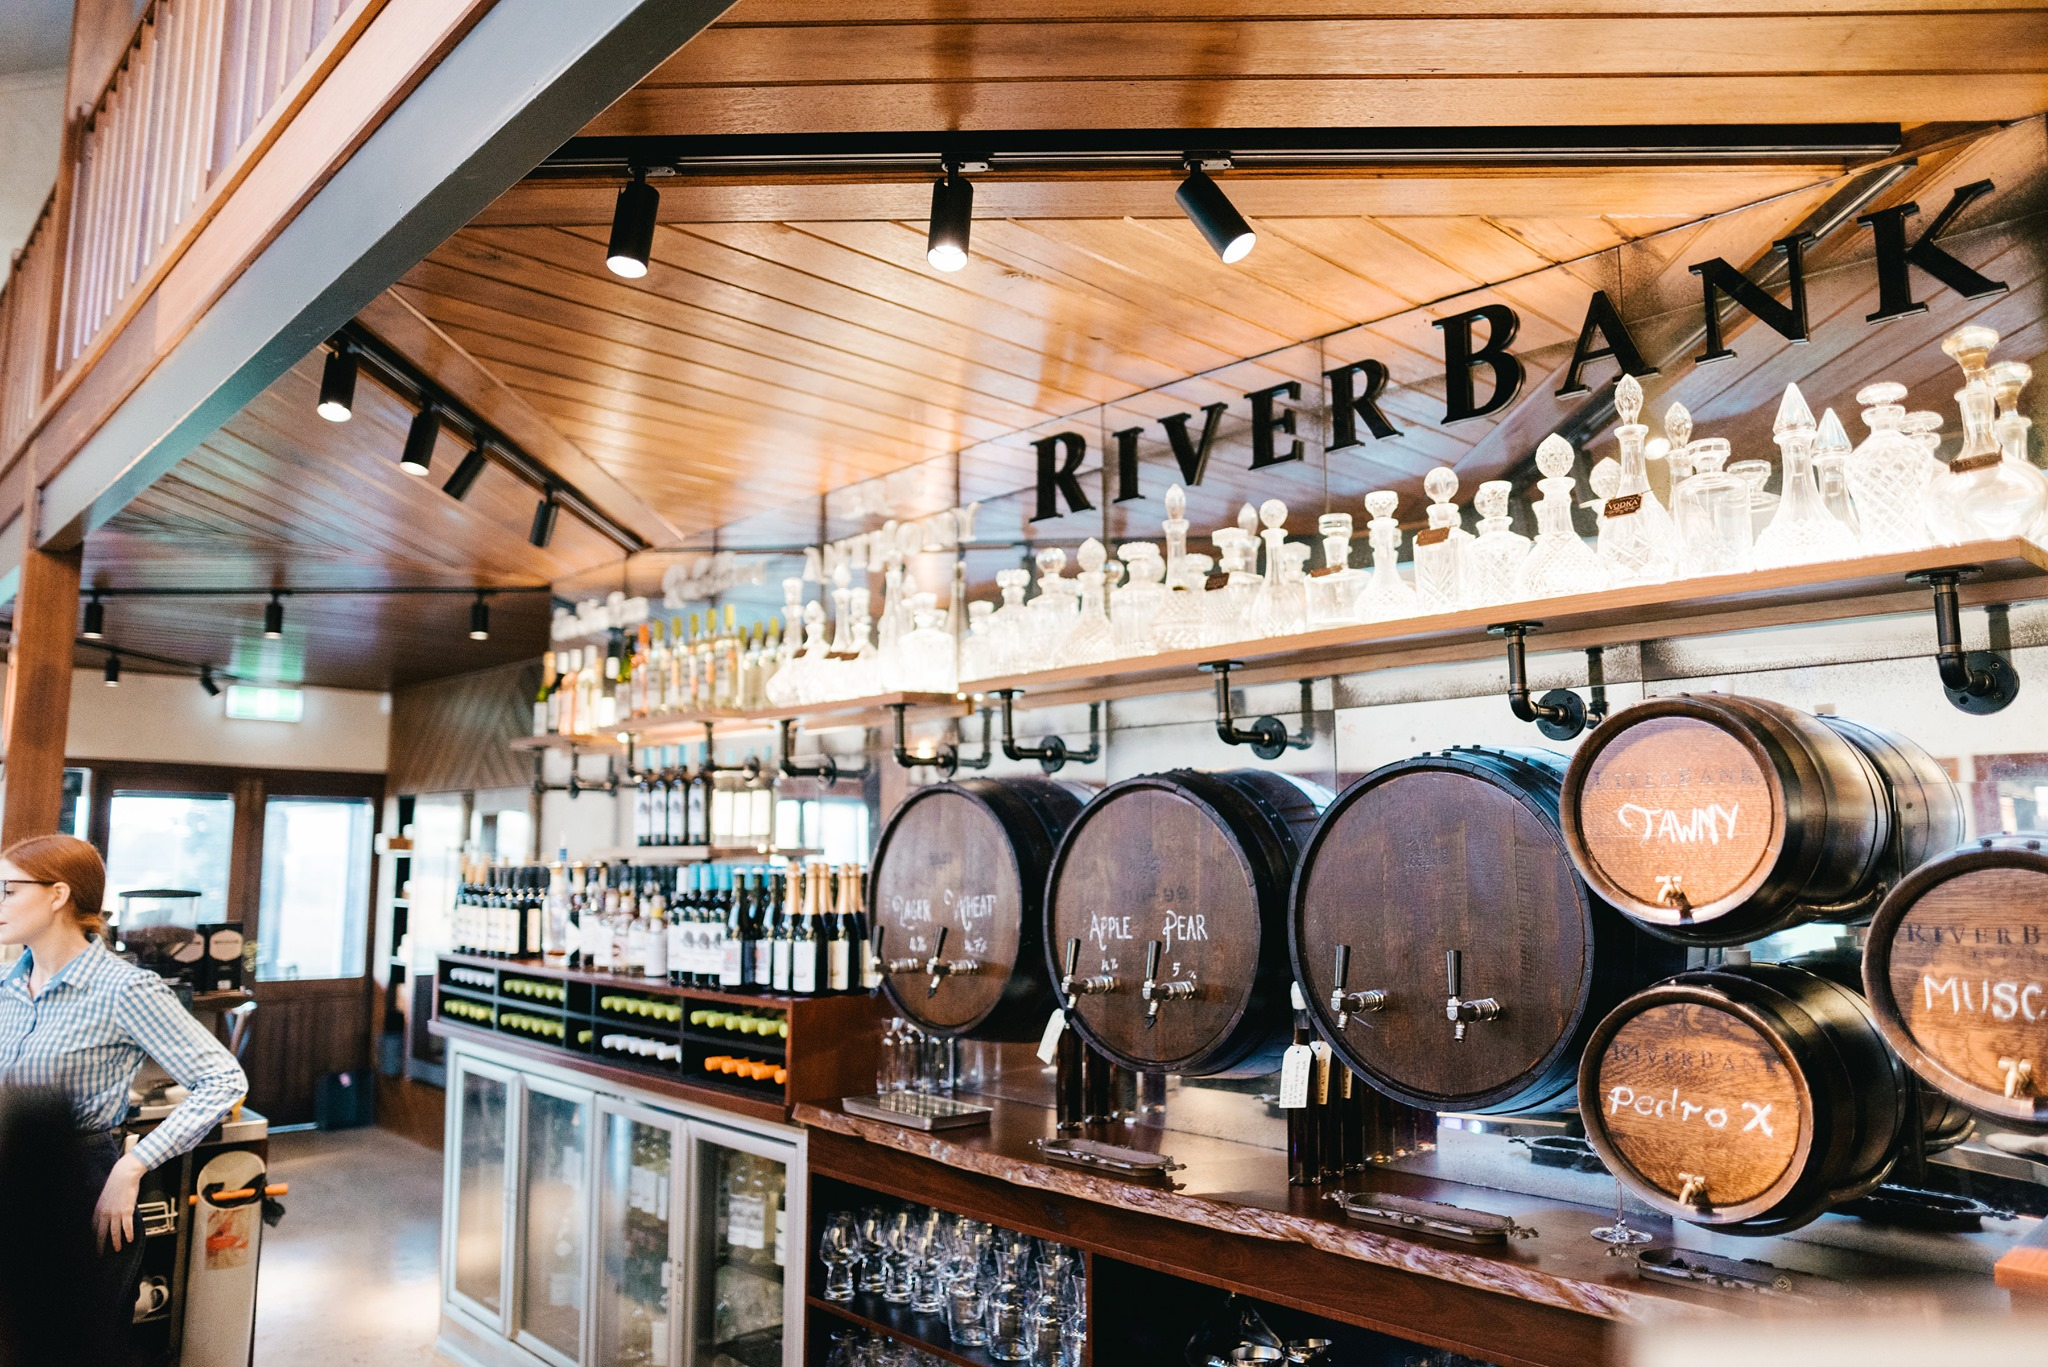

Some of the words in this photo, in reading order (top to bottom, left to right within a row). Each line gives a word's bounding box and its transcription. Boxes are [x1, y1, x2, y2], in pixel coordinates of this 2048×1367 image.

[1608, 499, 1638, 510] VODKA
[1617, 801, 1739, 845] TAWNY
[1088, 910, 1134, 951] APPLE
[1162, 909, 1209, 954] PEAR
[1607, 1086, 1728, 1129] Pedro
[1741, 1102, 1773, 1138] X
